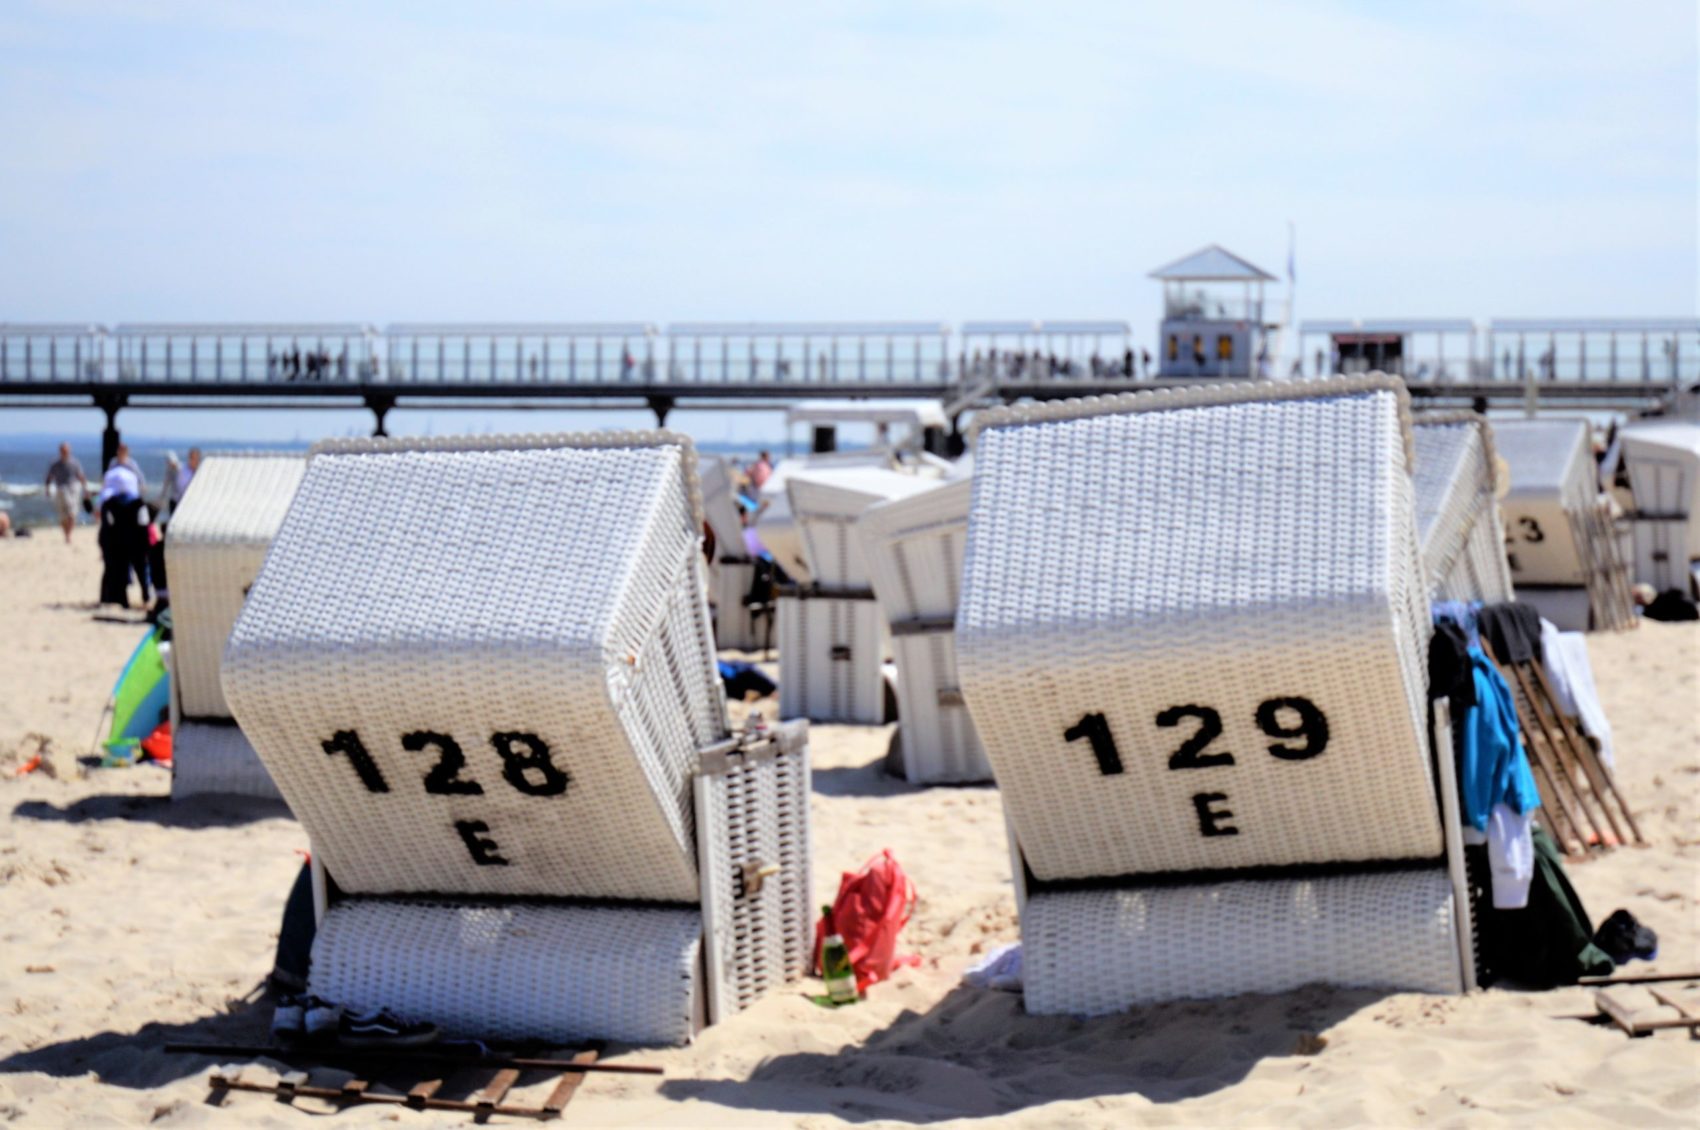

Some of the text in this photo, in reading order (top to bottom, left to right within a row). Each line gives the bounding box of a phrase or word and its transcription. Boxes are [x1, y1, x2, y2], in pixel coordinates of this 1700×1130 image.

[321, 728, 573, 797] 128
[1063, 695, 1331, 776] 129
[454, 819, 512, 867] E
[1191, 791, 1240, 838] E
